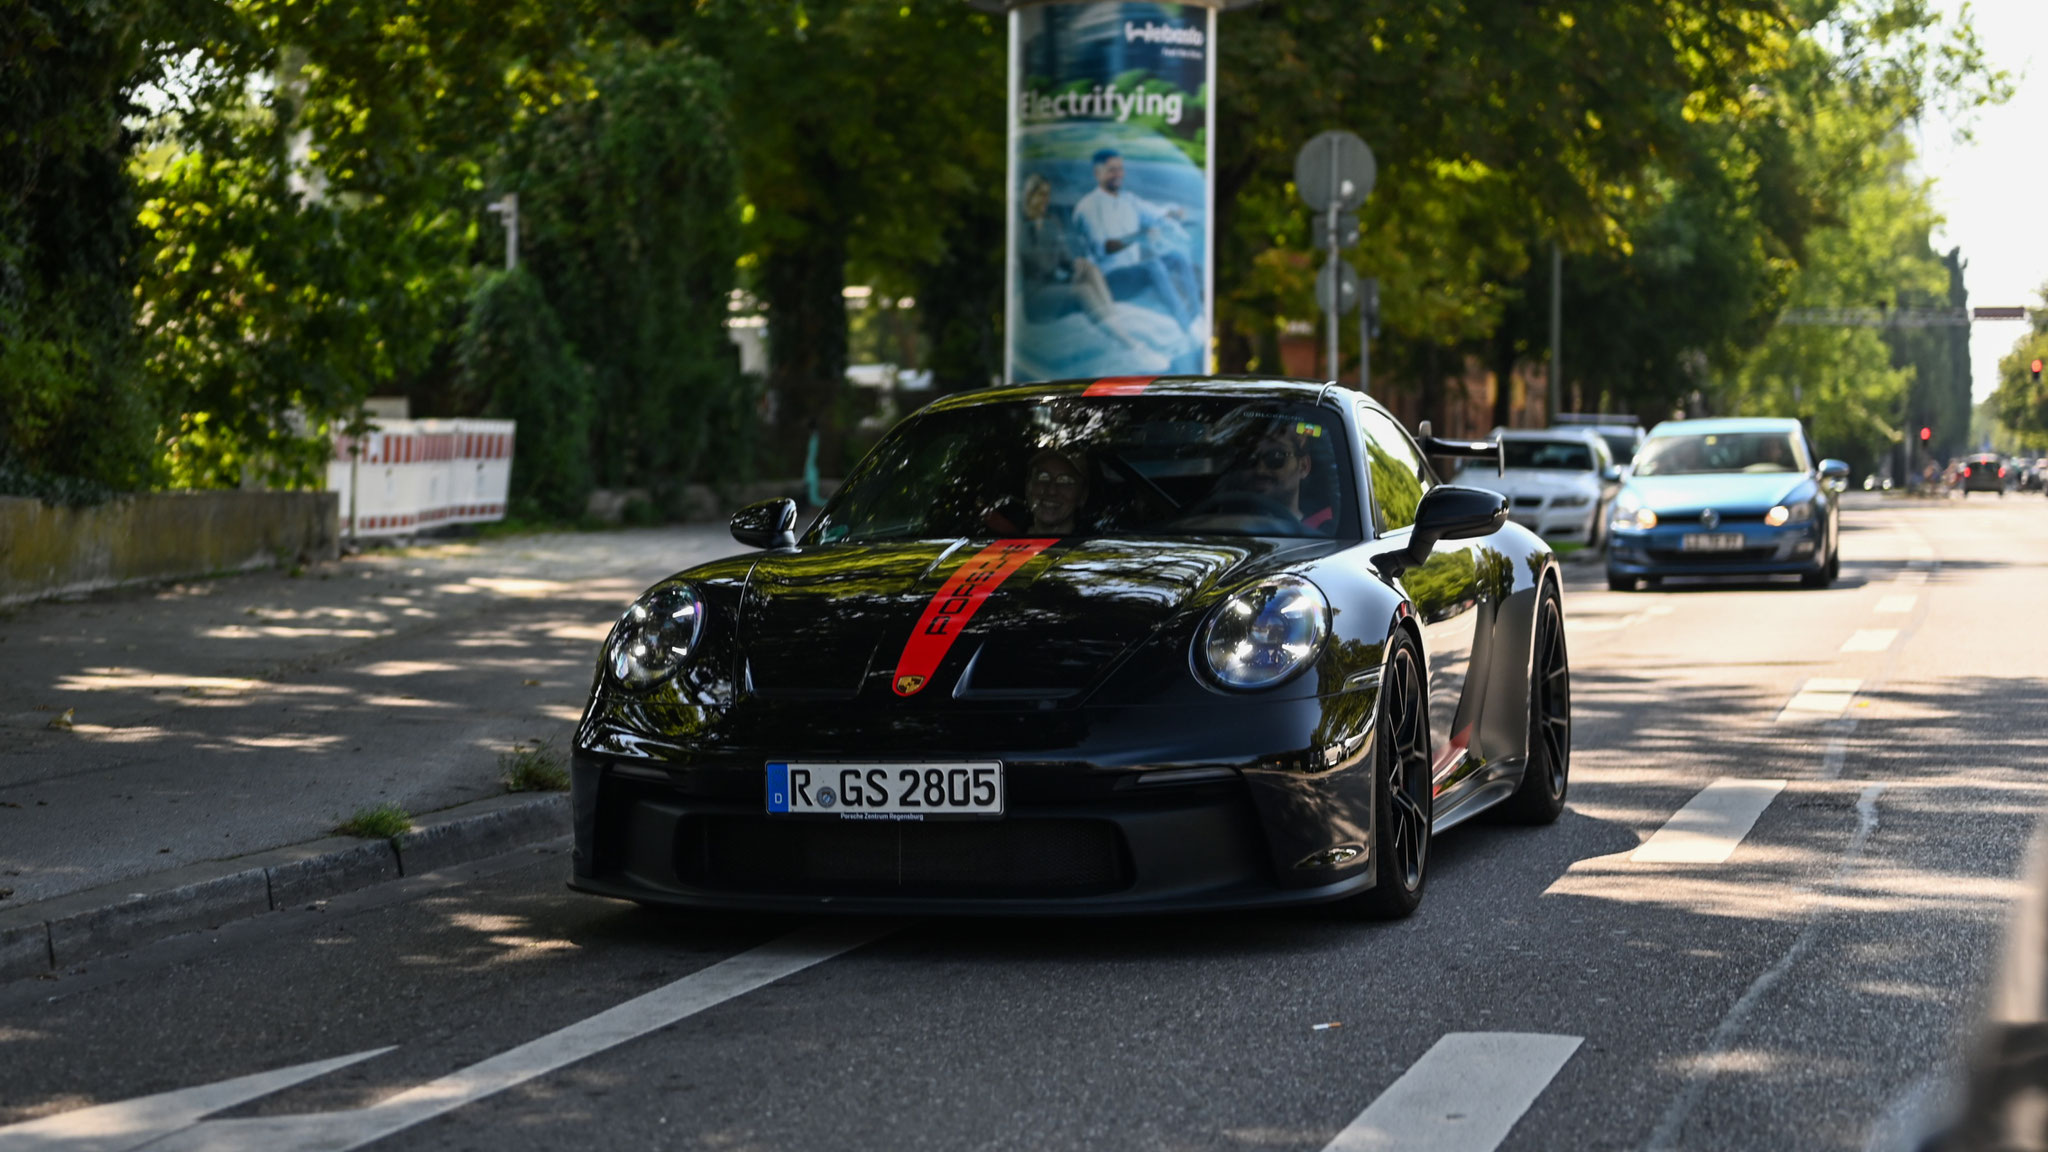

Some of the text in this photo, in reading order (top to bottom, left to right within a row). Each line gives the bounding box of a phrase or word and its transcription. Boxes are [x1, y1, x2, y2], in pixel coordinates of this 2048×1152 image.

[1019, 85, 1184, 125] Electrifying
[774, 792, 783, 804] D
[790, 769, 996, 807] R GS 2805
[841, 812, 924, 822] Porsche Zentrum Regensburg
